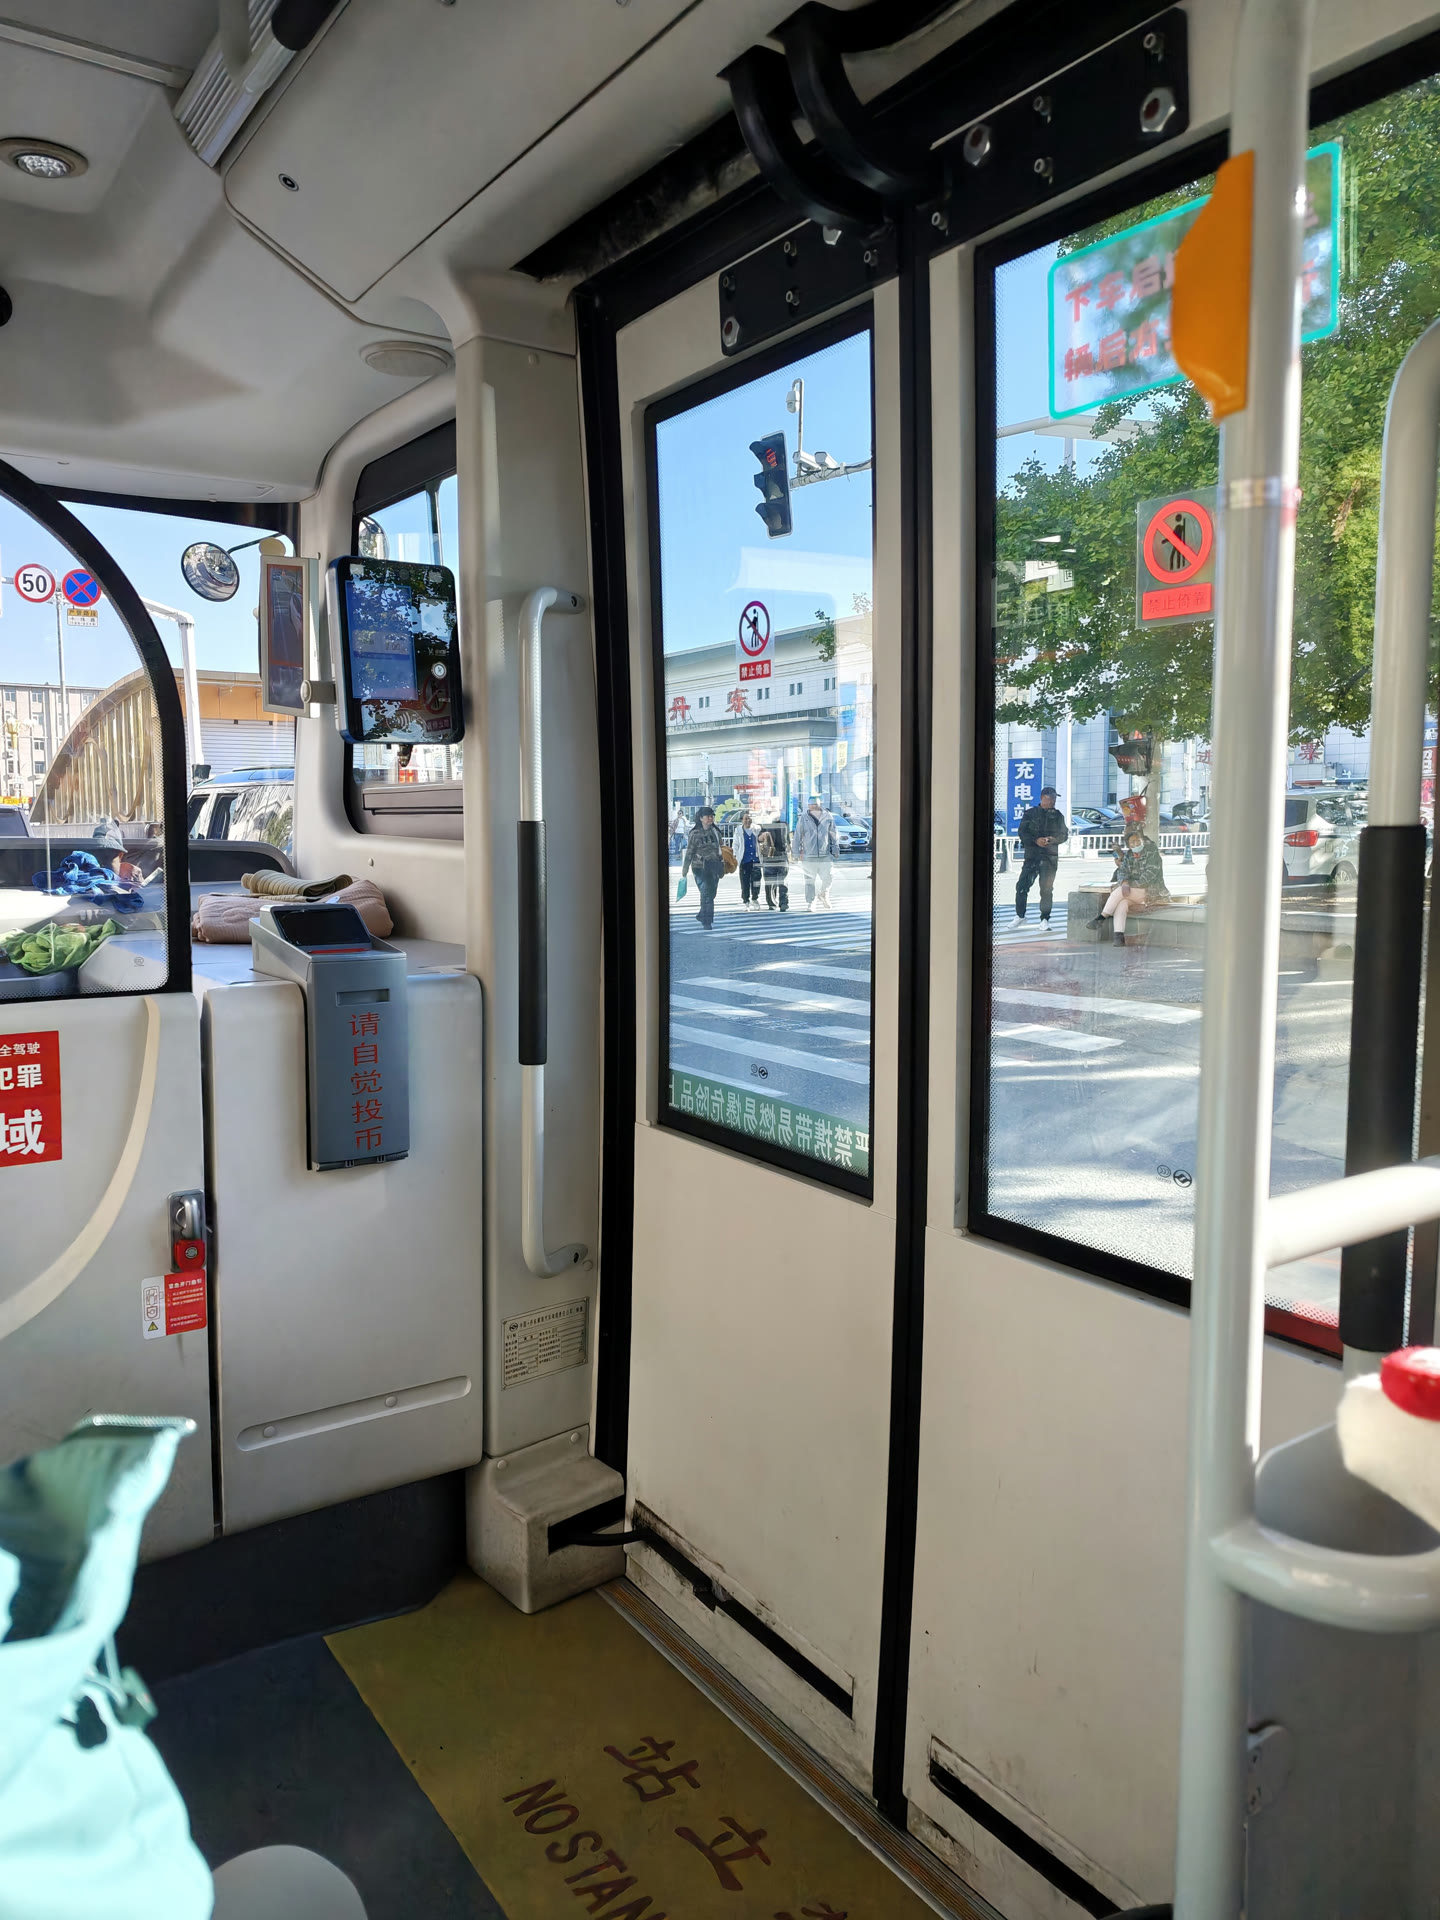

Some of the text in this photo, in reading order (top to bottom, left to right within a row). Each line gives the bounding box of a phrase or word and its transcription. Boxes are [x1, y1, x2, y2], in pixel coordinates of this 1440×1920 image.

[22, 573, 47, 593] 50
[1148, 592, 1205, 613] 禁止倚靠
[741, 663, 770, 678] 禁止倚靠
[668, 688, 753, 721] 丹东
[0, 1042, 41, 1057] 全驾驶
[348, 1012, 384, 1150] 请自觉投币
[0, 1108, 45, 1155] 域
